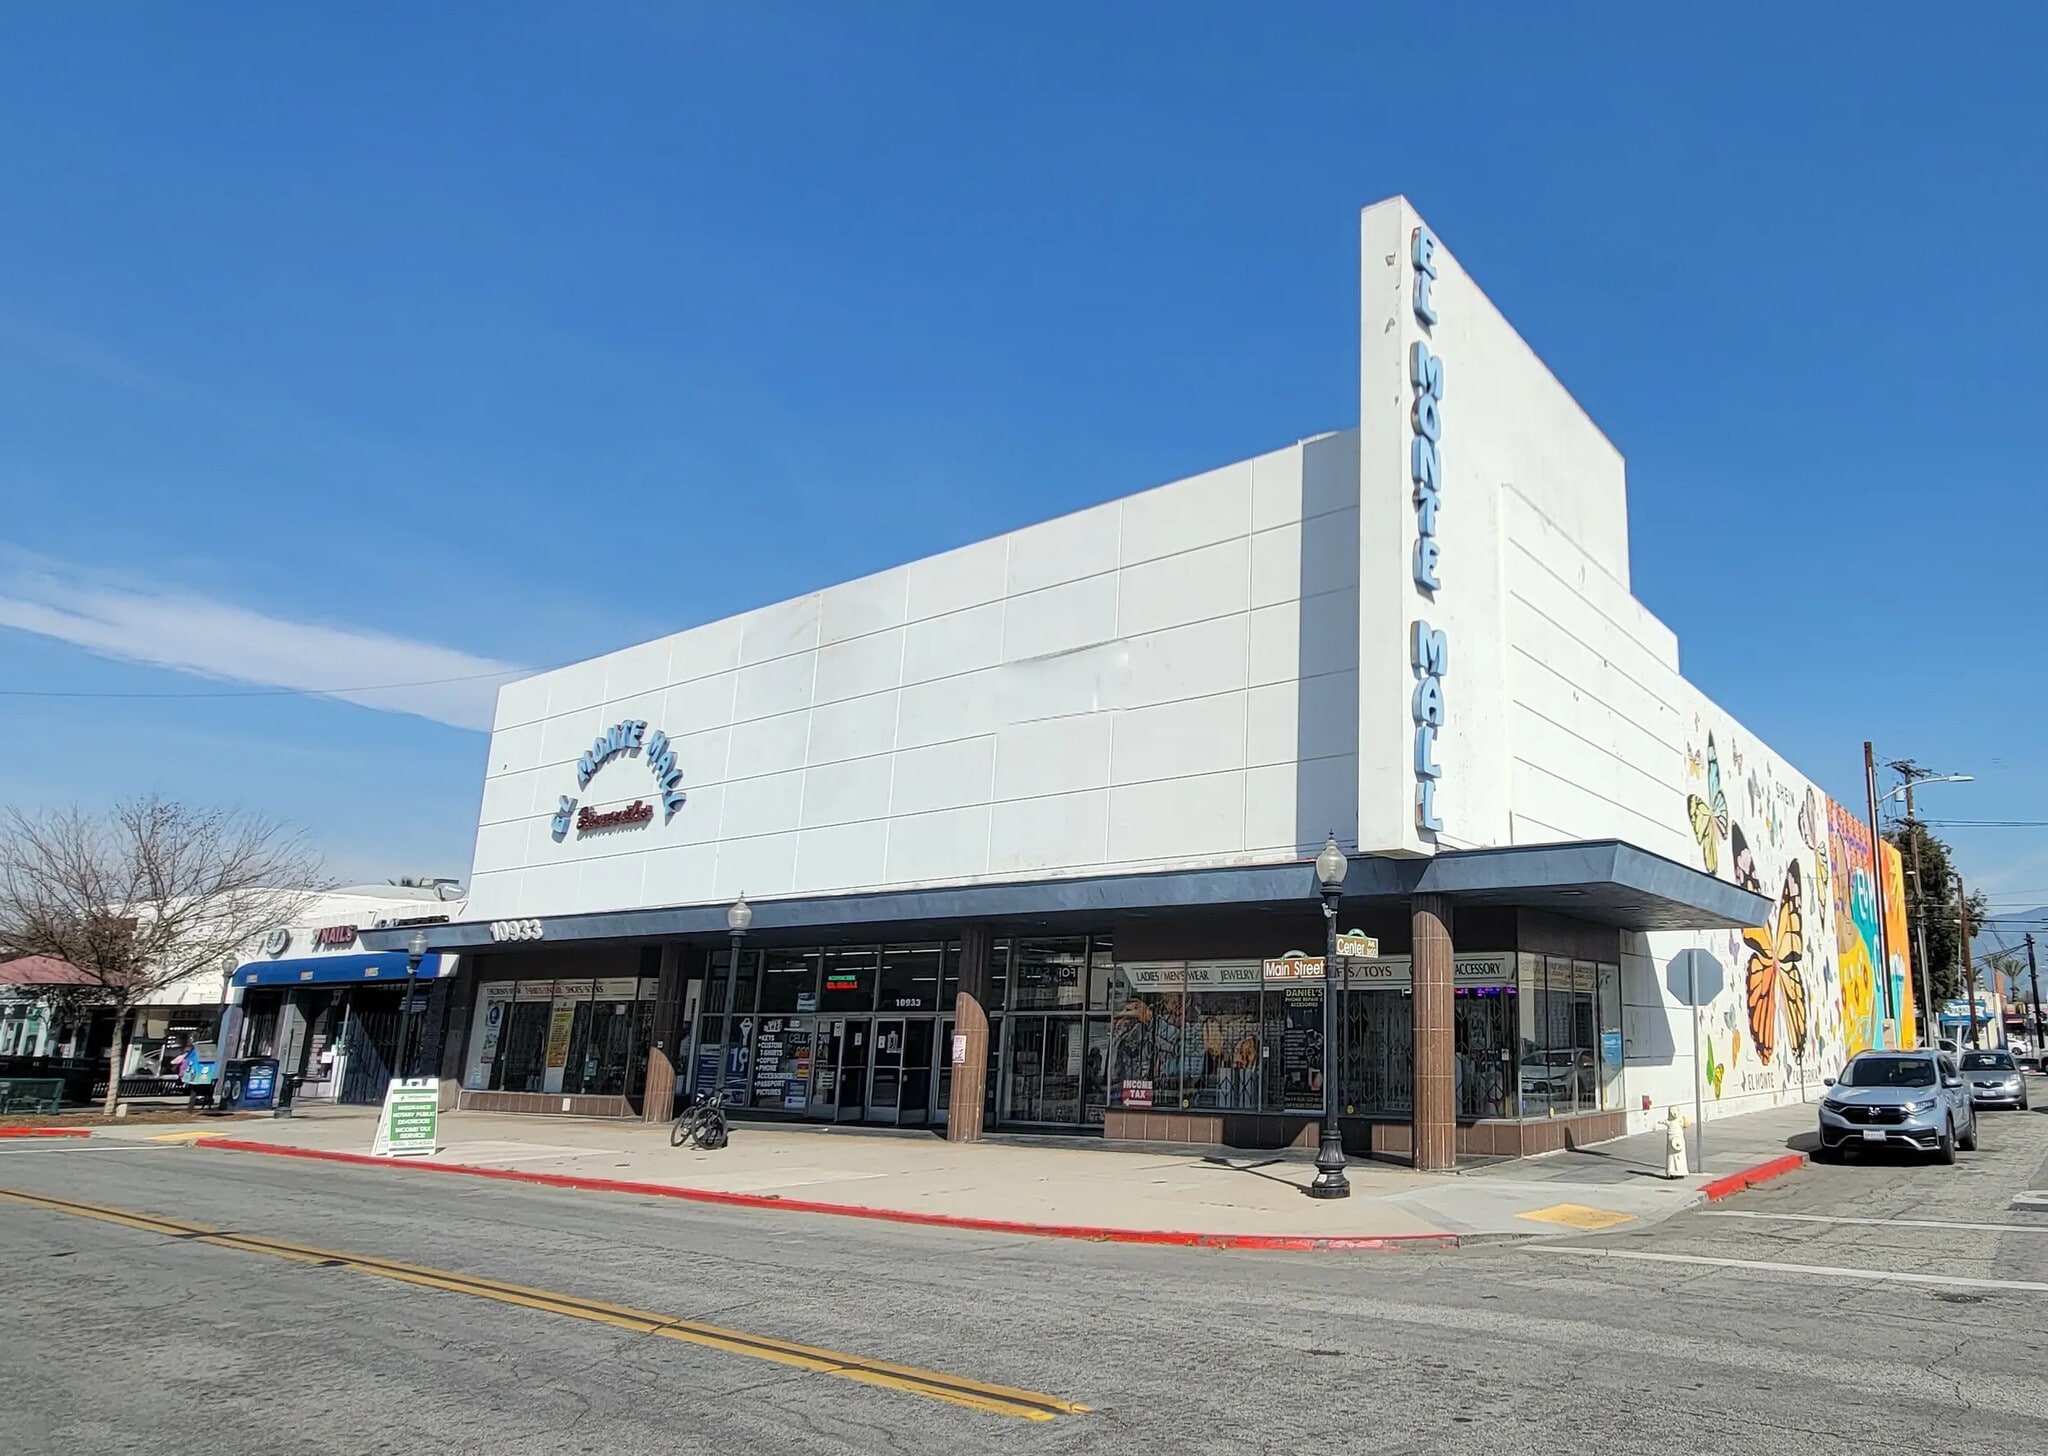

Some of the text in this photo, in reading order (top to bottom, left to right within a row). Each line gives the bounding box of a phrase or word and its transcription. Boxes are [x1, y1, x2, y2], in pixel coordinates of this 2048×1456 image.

[1410, 226, 1448, 833] EL MONTE MALL
[577, 719, 648, 783] MONTE
[646, 729, 687, 822] MALL
[321, 925, 357, 945] NAILS
[489, 919, 544, 942] 10933
[1336, 938, 1366, 956] Center
[1187, 968, 1210, 980] WEAR
[1265, 960, 1325, 977] Main Street
[1455, 962, 1502, 976] ACCESSORY
[1286, 988, 1323, 997] DANIEL'S
[895, 998, 922, 1007] 10933
[1122, 1079, 1153, 1089] INCOME
[1129, 1089, 1146, 1099] TAX
